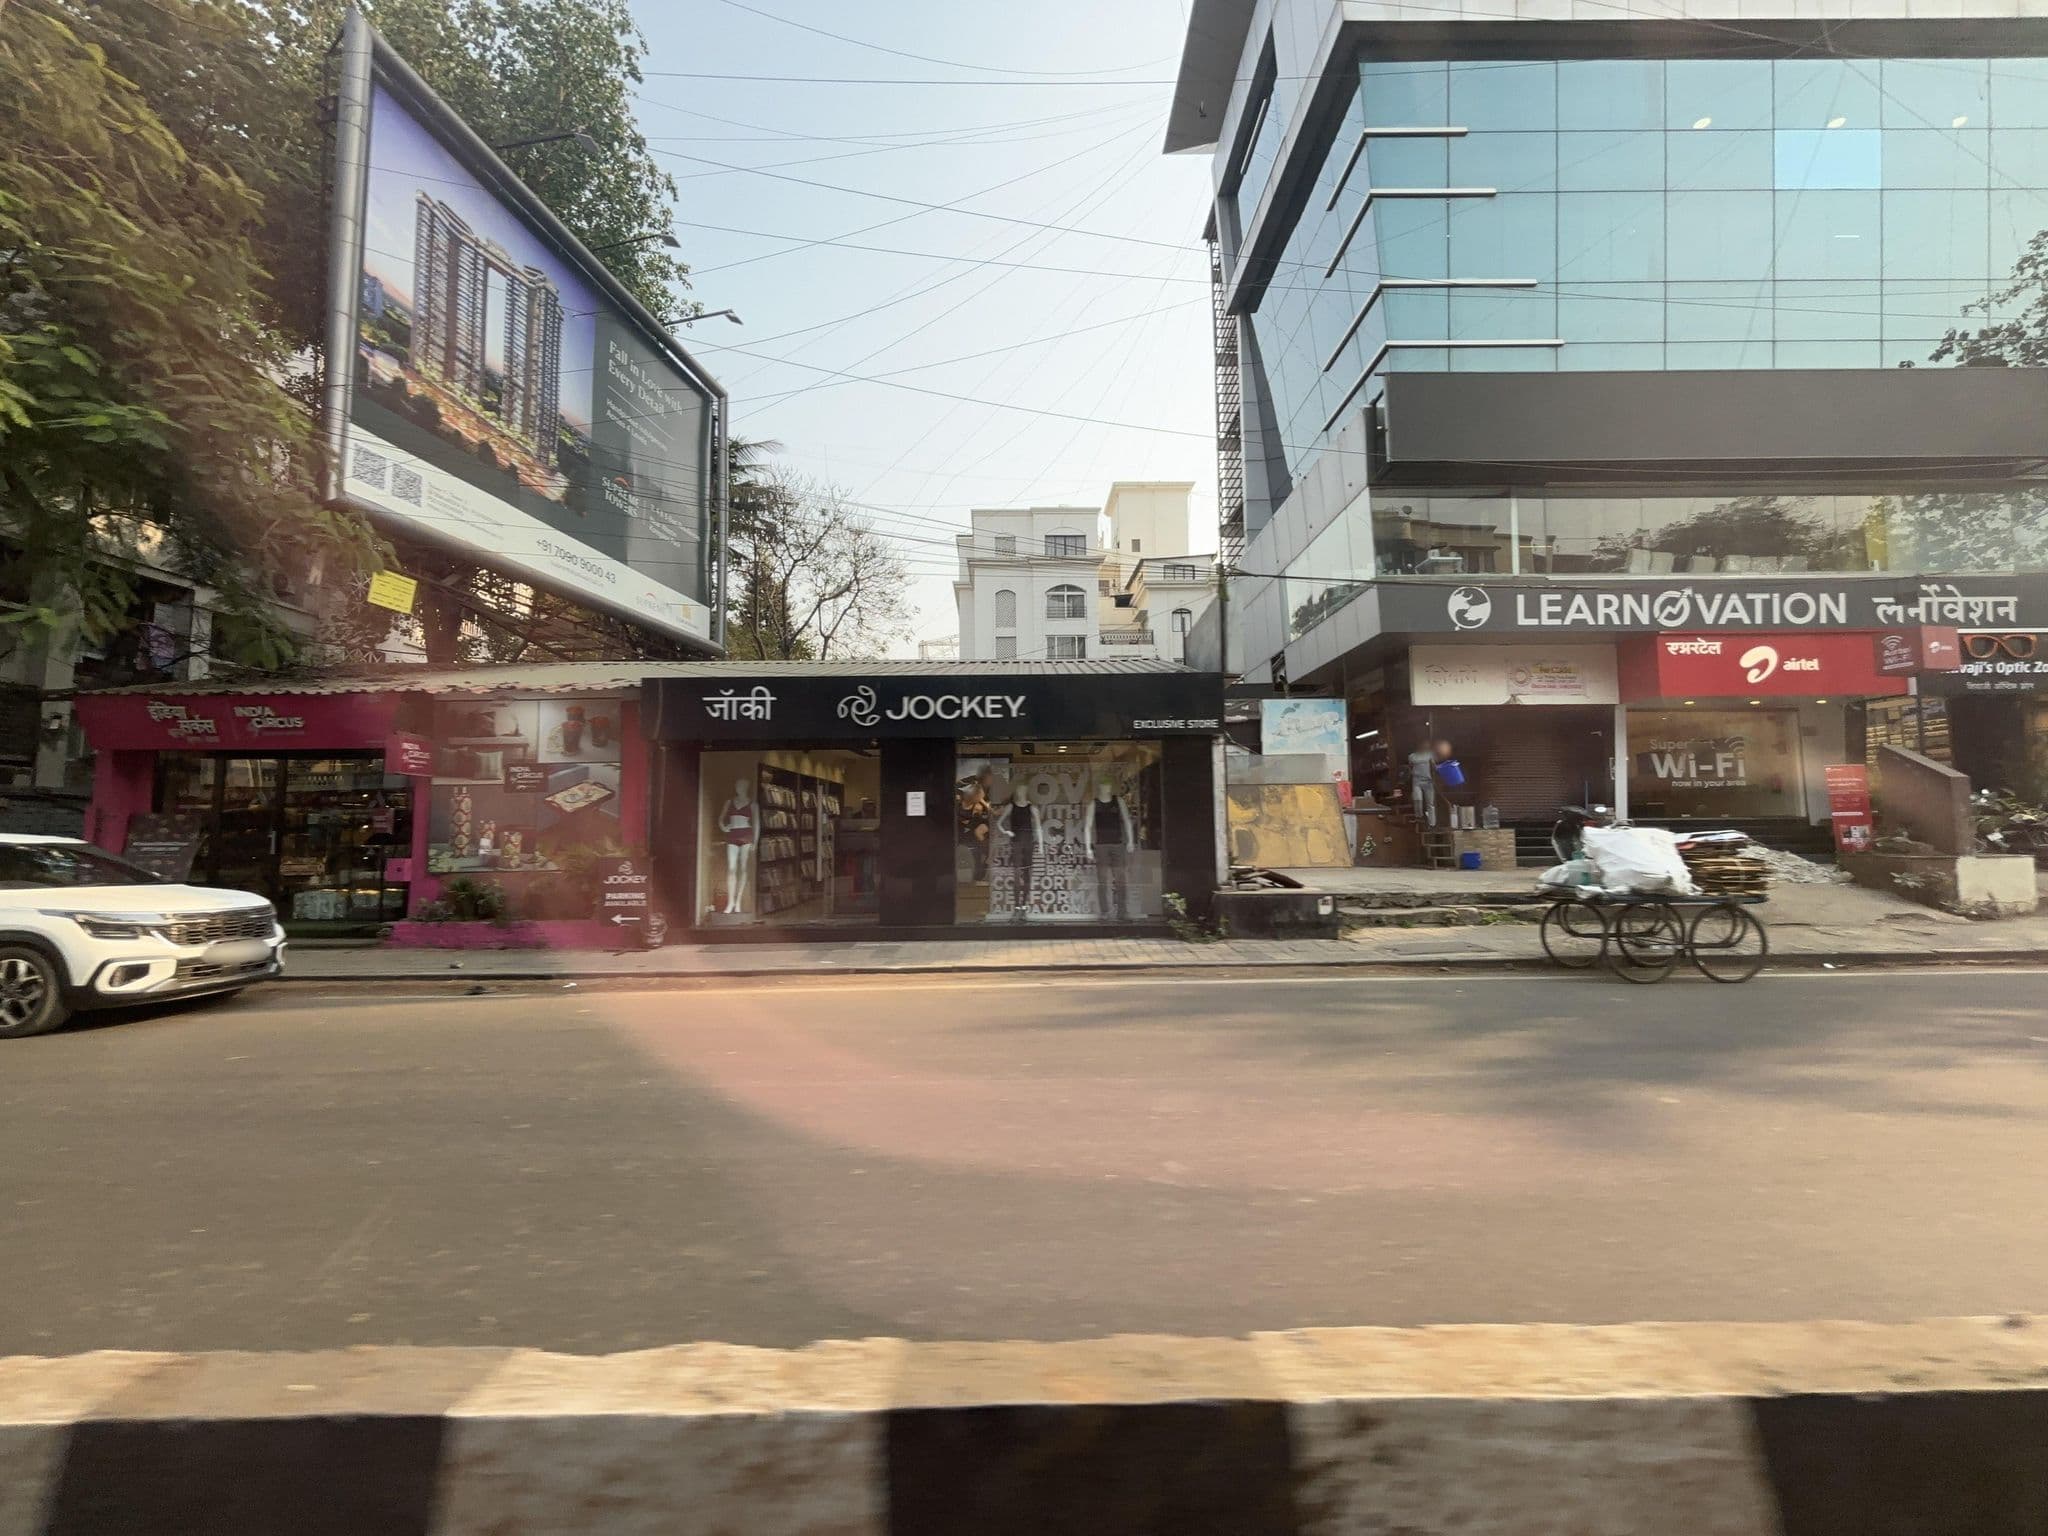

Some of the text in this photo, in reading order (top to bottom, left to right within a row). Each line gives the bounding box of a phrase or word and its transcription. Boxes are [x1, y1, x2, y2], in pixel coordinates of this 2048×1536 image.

[607, 340, 628, 366] Fall
[630, 359, 640, 377] in
[641, 369, 664, 399] Love
[607, 359, 637, 393] Every
[1516, 588, 1847, 628] LEARNOVATION
[1782, 657, 1820, 671] airtel
[1996, 661, 2032, 676] Optic
[702, 686, 778, 721] जॉकी
[886, 695, 1026, 720] JOCKEY
[232, 706, 275, 718] INDIA
[252, 716, 305, 729] CIRCUS
[1187, 719, 1220, 729] STORE
[1650, 752, 1746, 778] Wi-Fi
[1704, 780, 1725, 789] your
[603, 874, 648, 885] JOCKEY
[605, 892, 647, 900] PARKING
